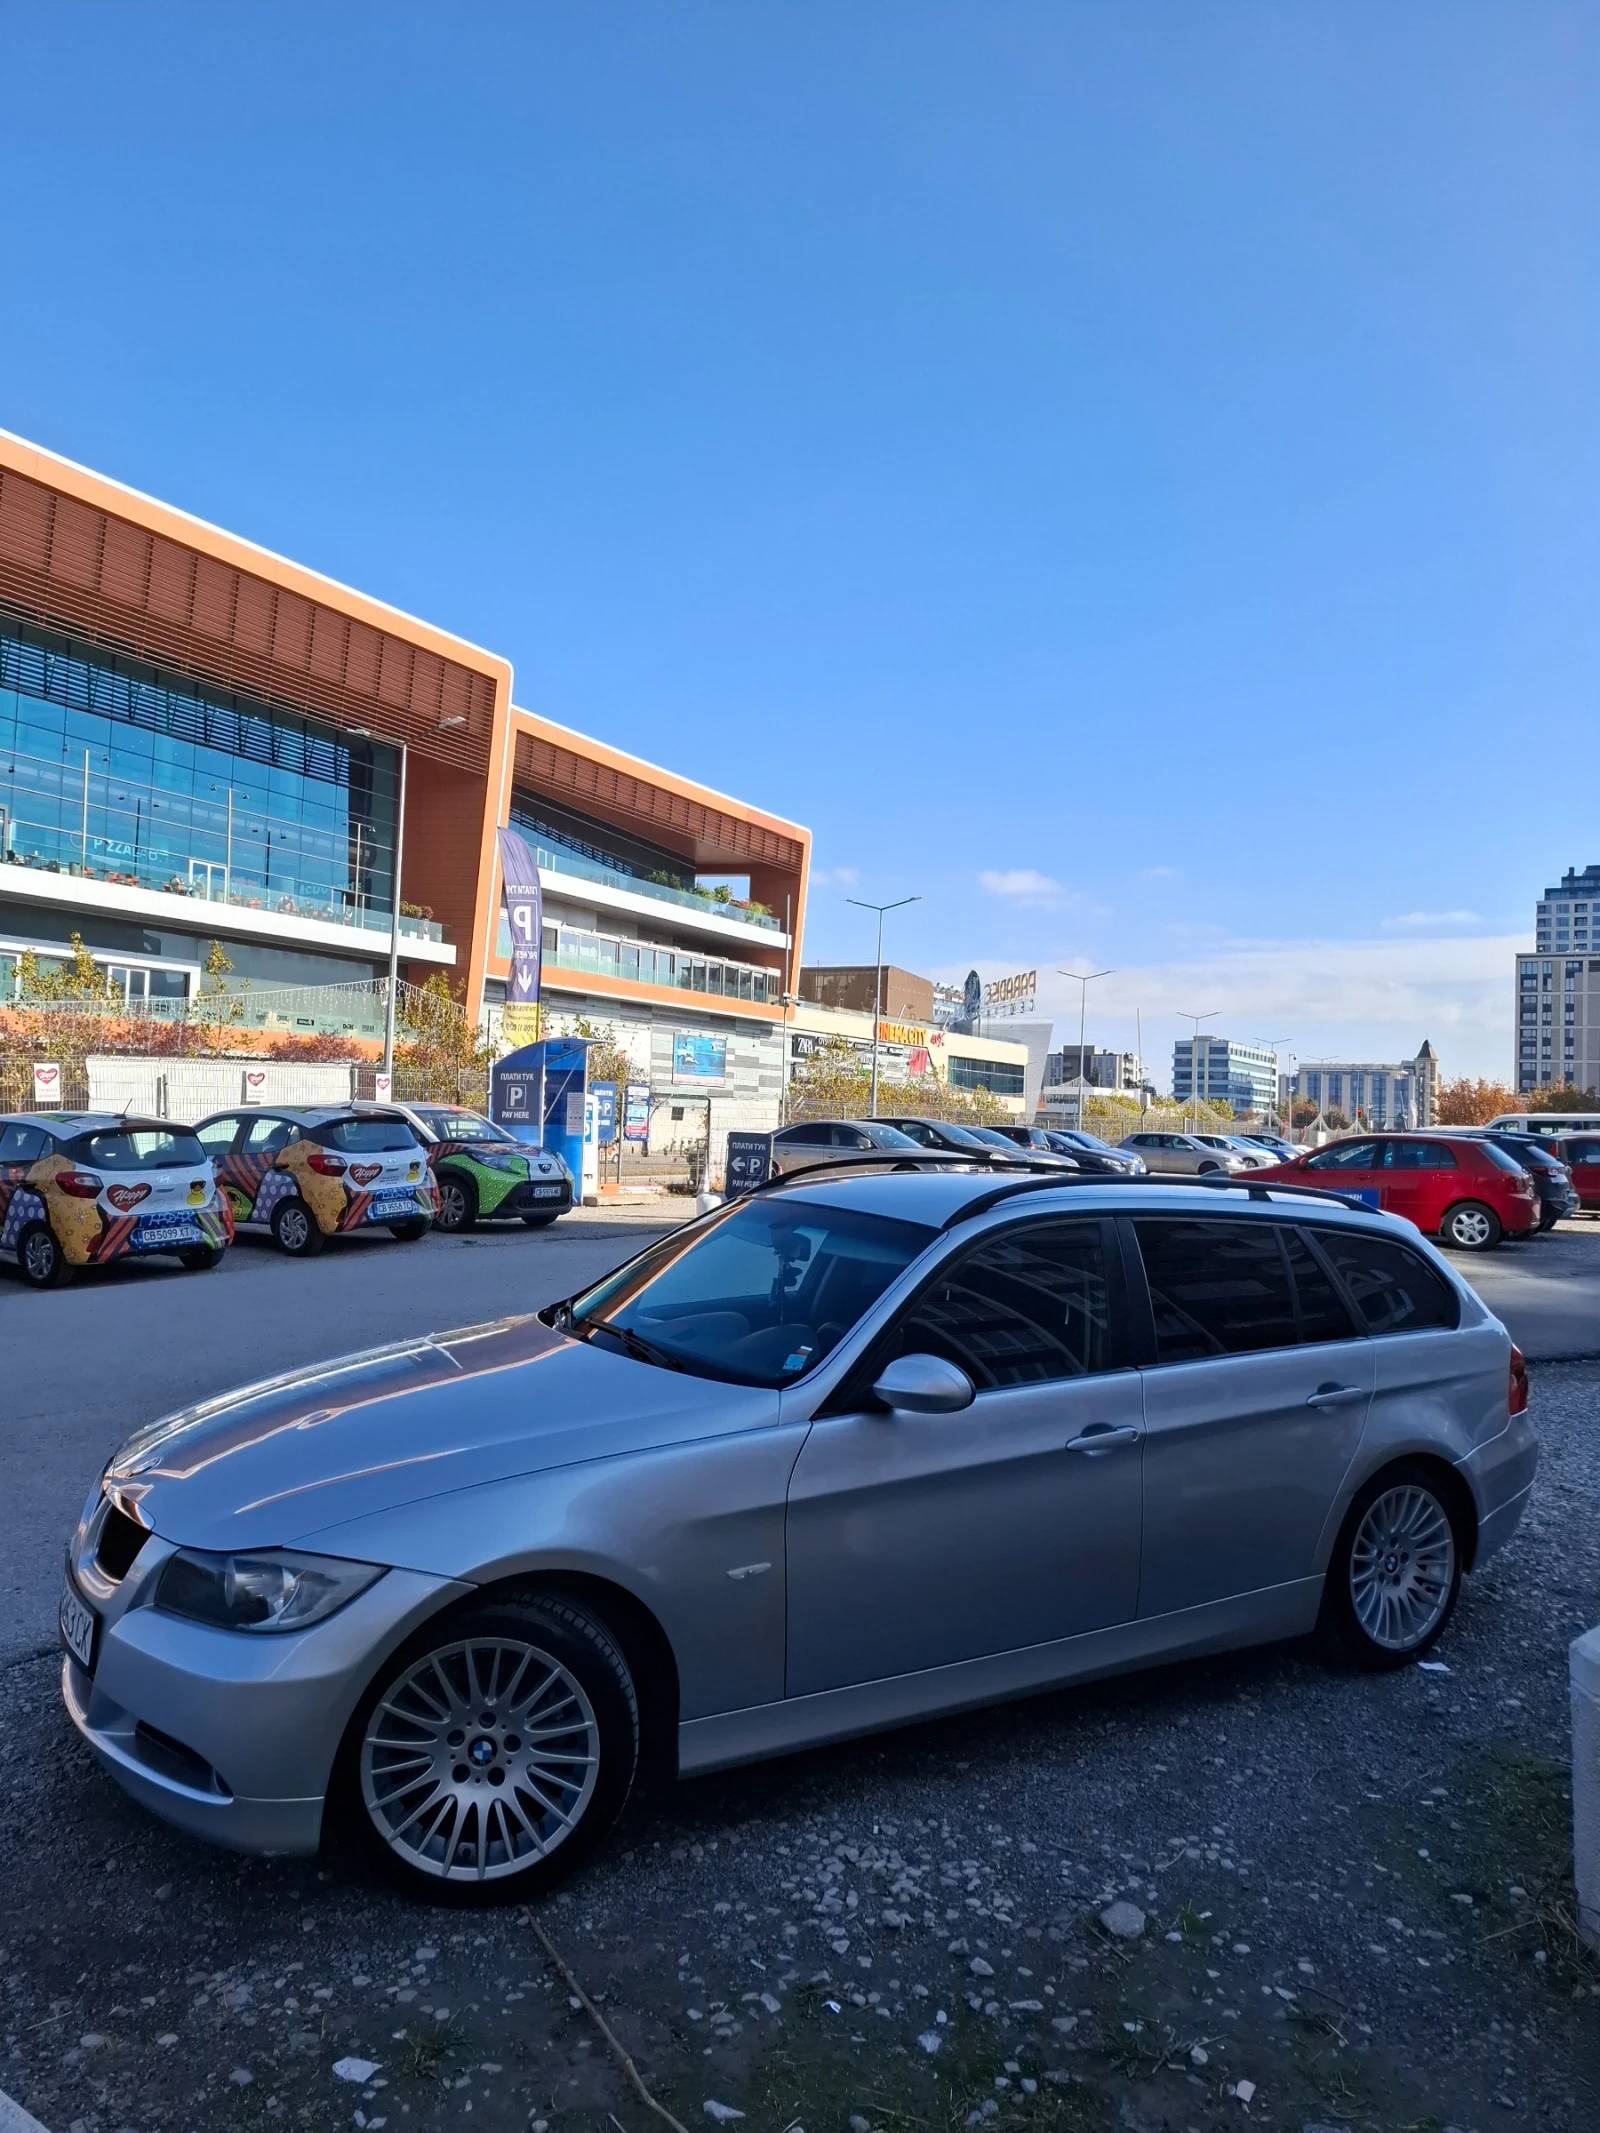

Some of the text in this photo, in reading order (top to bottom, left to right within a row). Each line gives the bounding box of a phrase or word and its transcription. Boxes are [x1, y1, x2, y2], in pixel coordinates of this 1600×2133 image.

[873, 1021, 927, 1046] INEMA CITY
[797, 1037, 814, 1054] ZARA
[500, 1073, 535, 1081] ПЛАТИ ТУК
[510, 1087, 523, 1106] P
[501, 1111, 530, 1119] PAY HERE
[732, 1142, 766, 1151] ПЛАТИ ТУК
[750, 1158, 760, 1173] P
[353, 1168, 380, 1179] Happy
[112, 1189, 148, 1203] Happy
[378, 1204, 388, 1213] CB
[144, 1227, 190, 1241] CB 5099 XT
